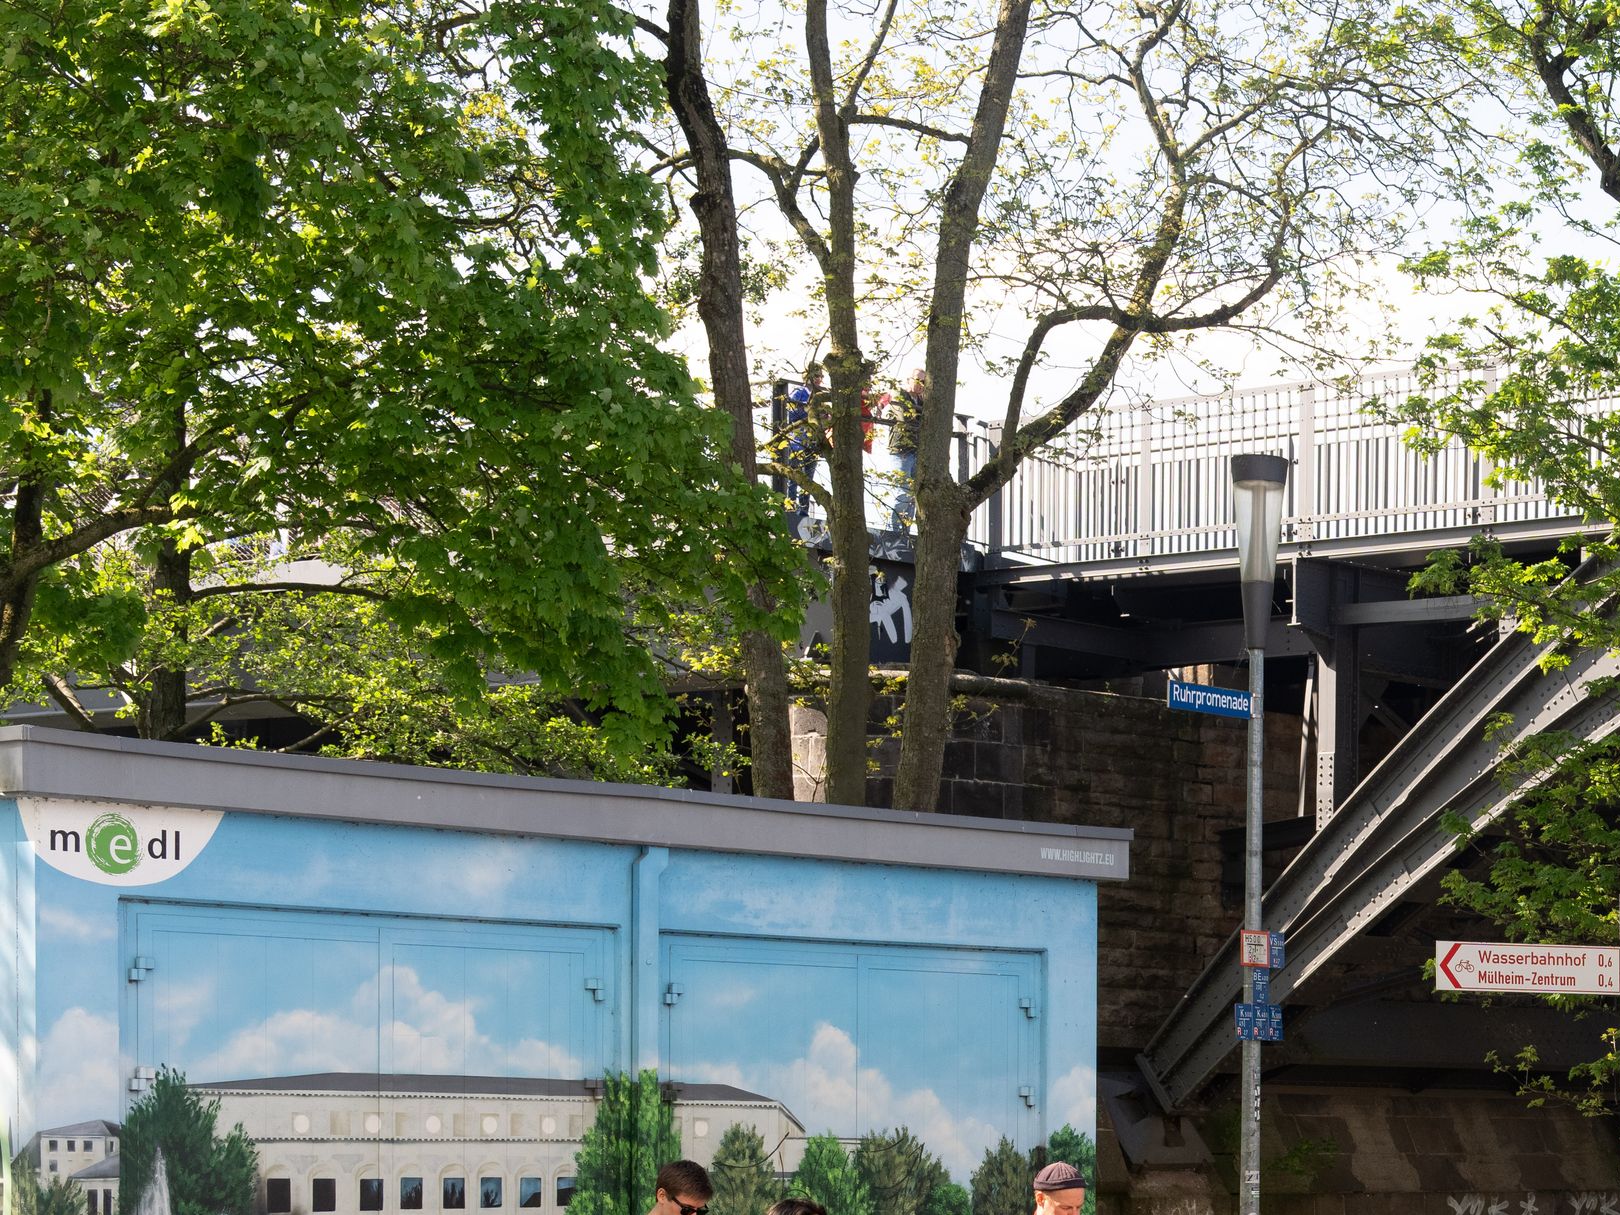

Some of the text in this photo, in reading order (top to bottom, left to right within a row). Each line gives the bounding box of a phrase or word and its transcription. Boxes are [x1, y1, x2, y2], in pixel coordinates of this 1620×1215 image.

[1173, 684, 1248, 711] Ruhrpromenade
[50, 829, 180, 864] medl
[1041, 847, 1114, 866] WWW.HIGHLIGHTZ.EU
[1478, 950, 1587, 967] Wasserbahnhof
[1478, 971, 1576, 987] Mülheim-Zentrum
